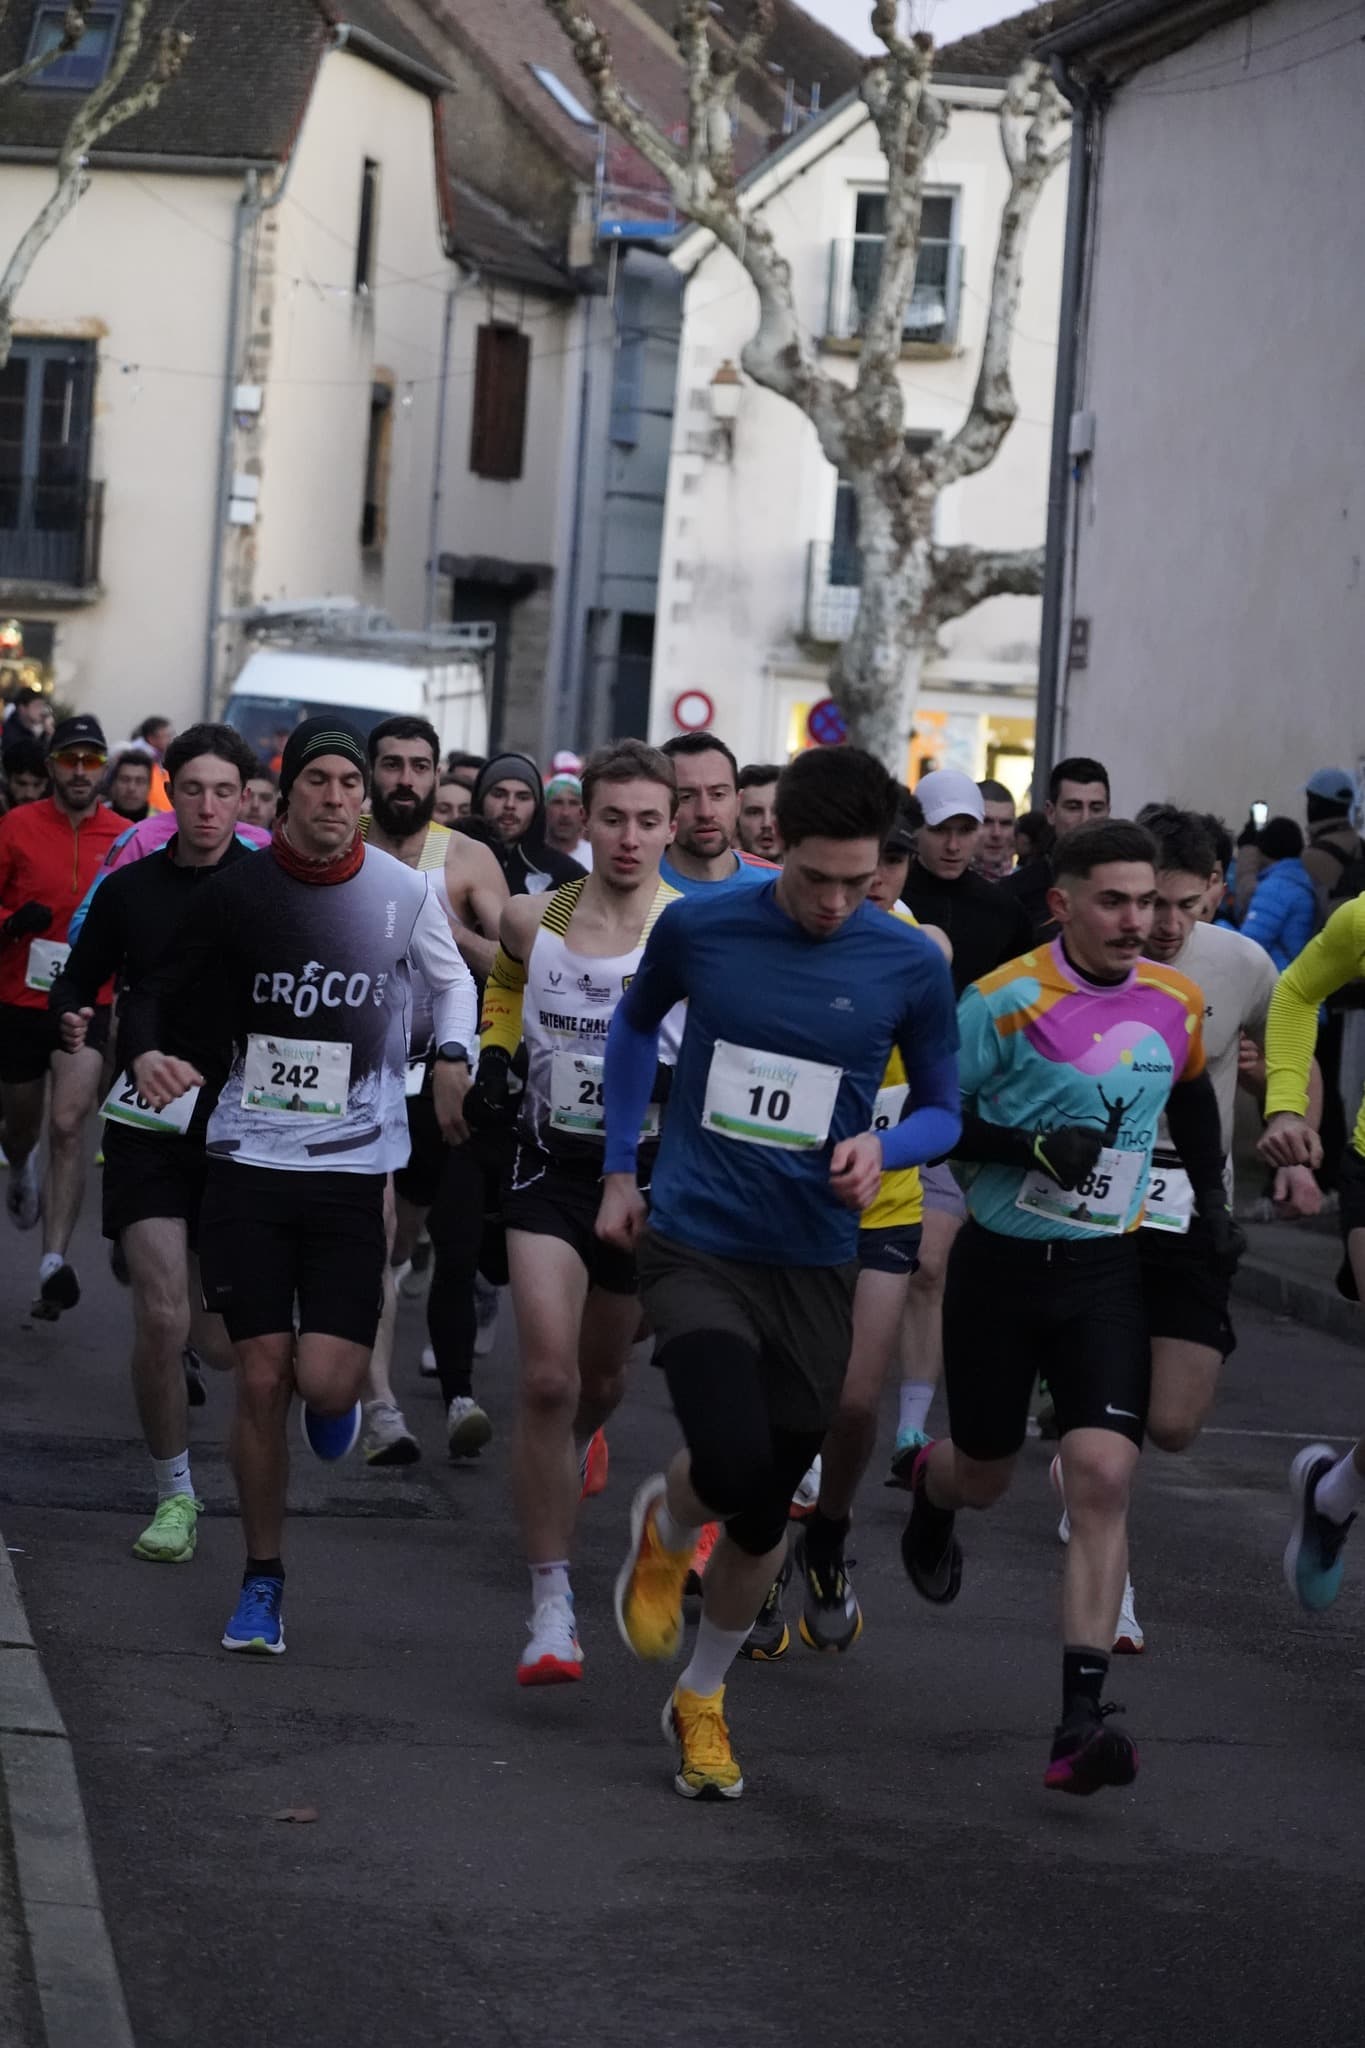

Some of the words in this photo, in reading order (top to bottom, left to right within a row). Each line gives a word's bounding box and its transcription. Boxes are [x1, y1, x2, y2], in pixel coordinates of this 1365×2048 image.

[253, 971, 371, 1018] CROCO
[540, 1011, 577, 1031] ENTENTE
[271, 1062, 319, 1089] 242
[749, 1085, 790, 1121] 10
